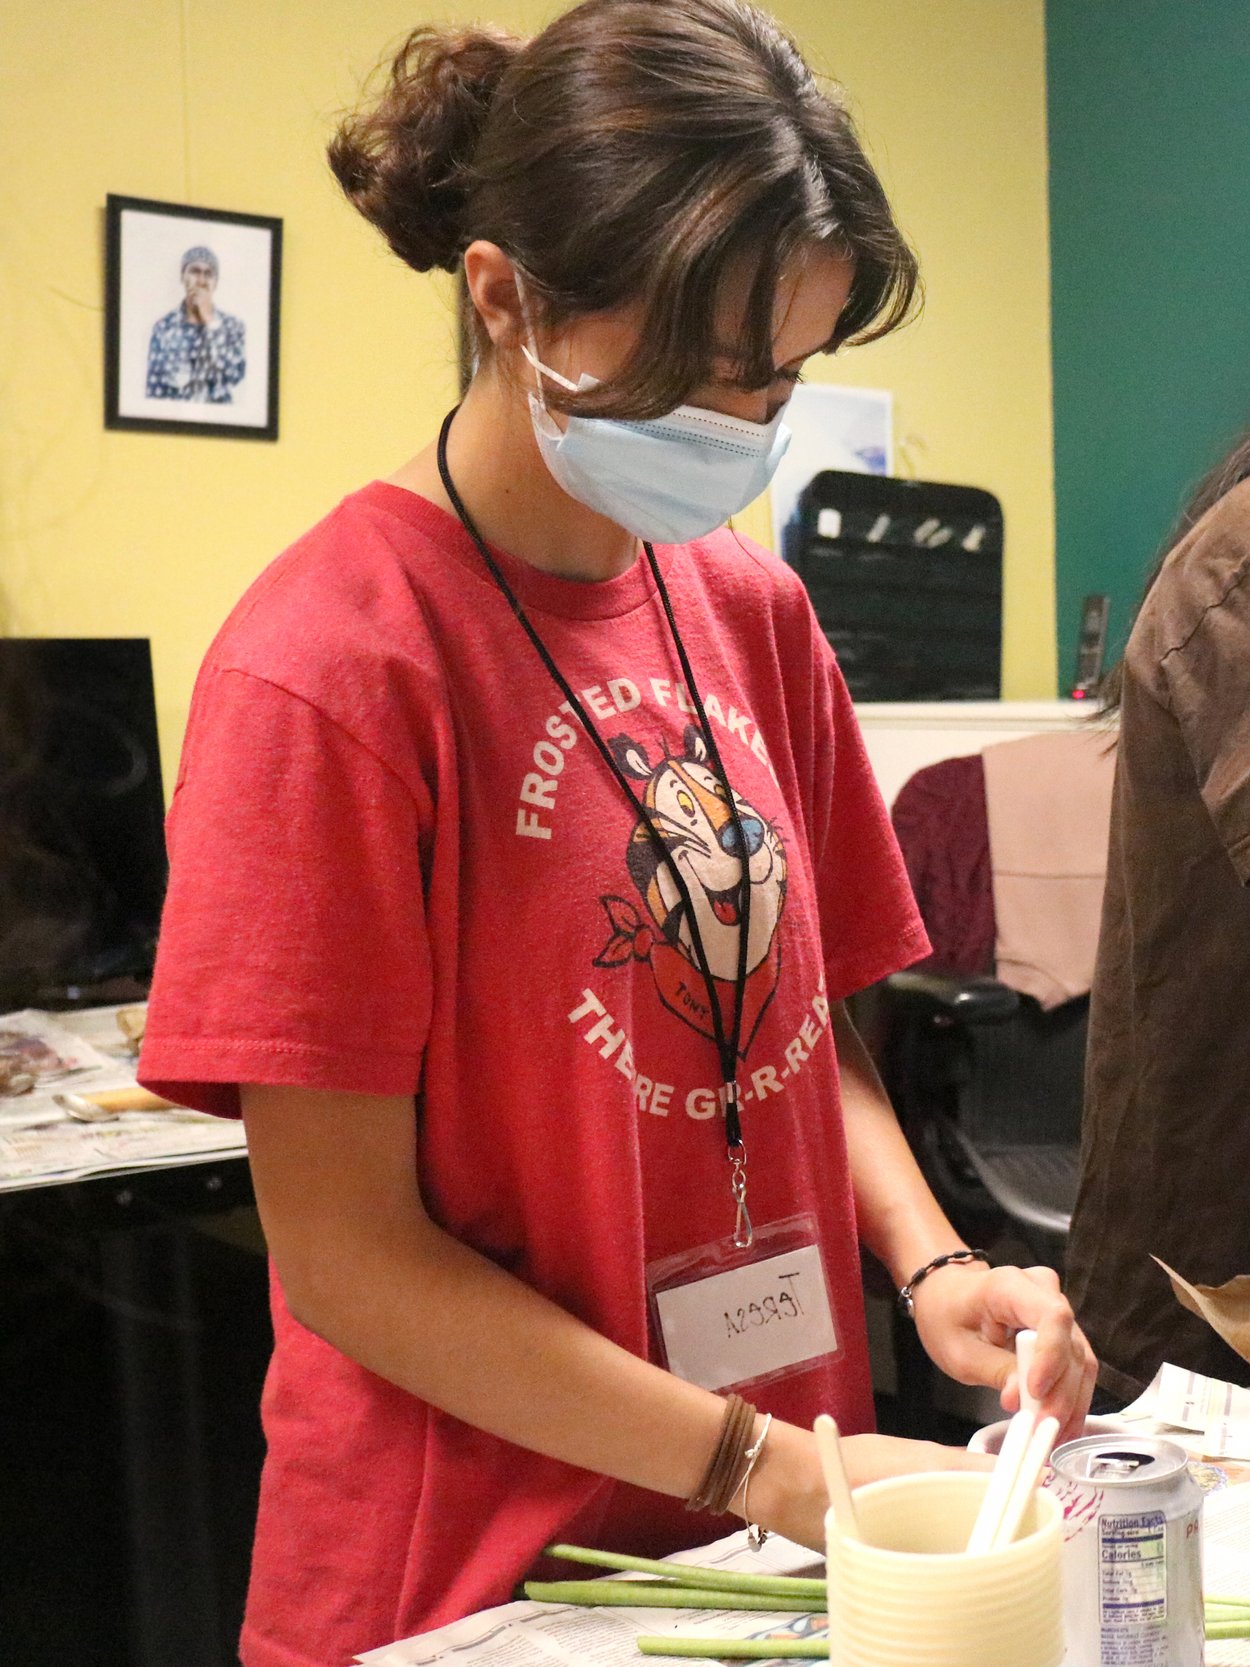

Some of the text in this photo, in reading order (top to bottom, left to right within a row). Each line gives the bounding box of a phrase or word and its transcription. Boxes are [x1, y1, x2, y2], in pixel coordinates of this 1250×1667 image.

[515, 677, 780, 840] FROSTED FLAKE
[1102, 1515, 1164, 1529] Nutrition Facts
[1102, 1548, 1142, 1560] Calories
